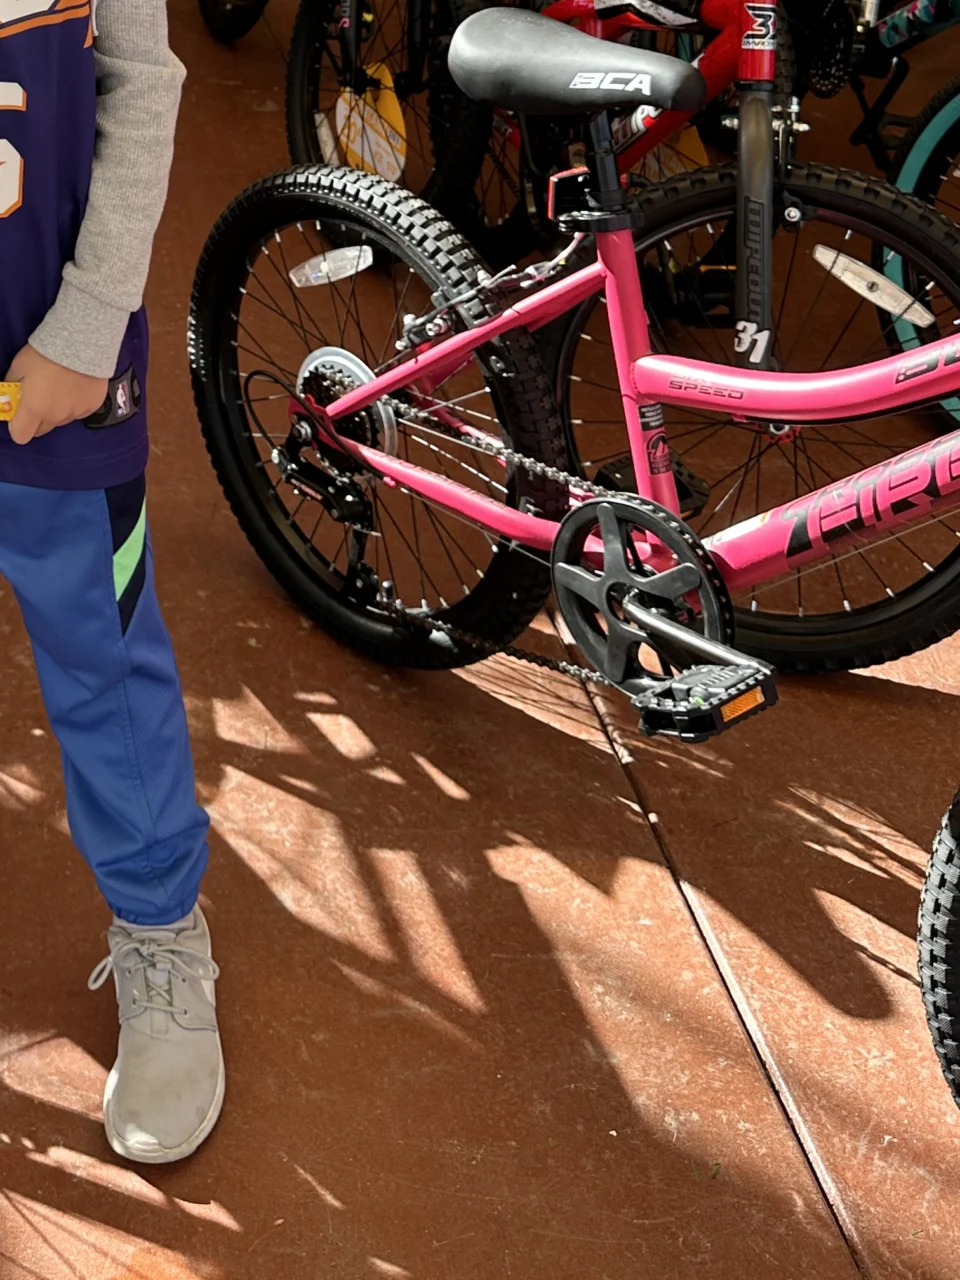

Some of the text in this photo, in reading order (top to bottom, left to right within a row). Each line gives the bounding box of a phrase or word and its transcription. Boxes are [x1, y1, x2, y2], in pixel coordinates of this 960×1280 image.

[568, 71, 652, 97] BCA
[734, 320, 771, 364] 31
[667, 380, 745, 401] SPEED
